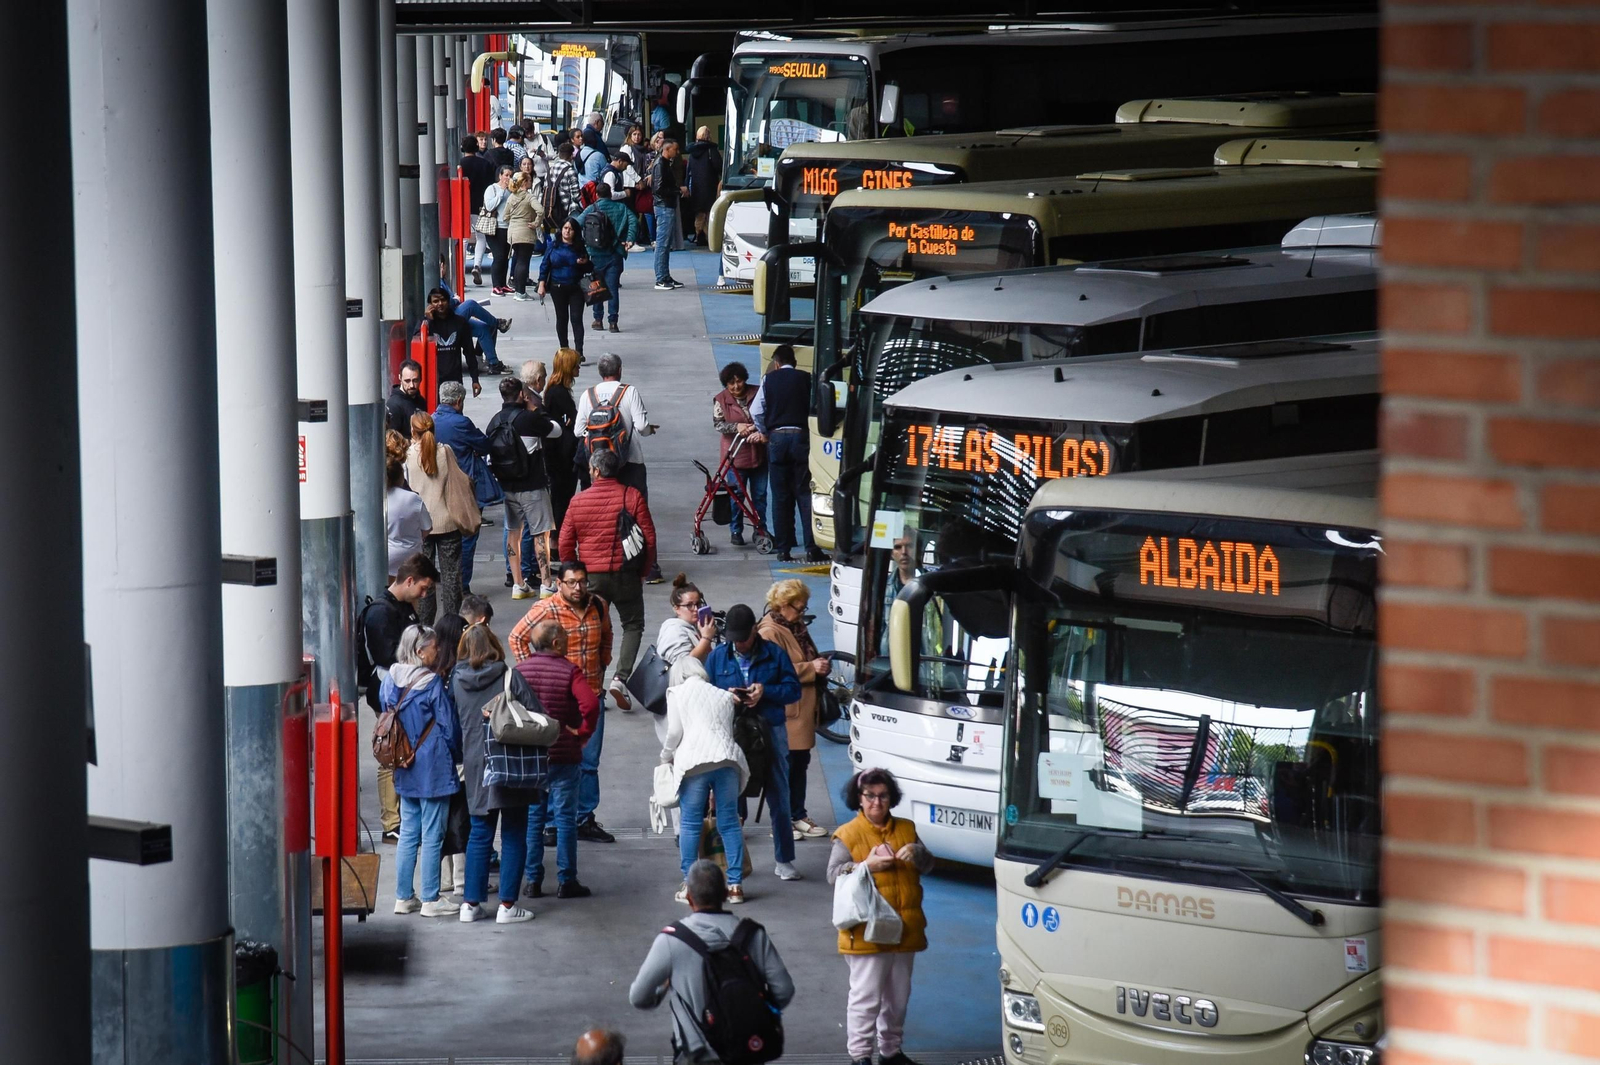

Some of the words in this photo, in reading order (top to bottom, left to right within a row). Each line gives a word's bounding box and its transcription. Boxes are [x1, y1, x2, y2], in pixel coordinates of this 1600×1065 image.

[783, 62, 826, 78] SEVILLA
[803, 167, 838, 196] M166
[888, 222, 907, 238] Por
[910, 223, 958, 240] Castilleja
[961, 226, 974, 241] de
[907, 239, 917, 254] la
[920, 240, 956, 256] Cuesta
[1139, 535, 1280, 596] ALBAIDA
[871, 712, 898, 724] VOLVO
[937, 808, 966, 827] 2120
[968, 812, 992, 831] HMN
[1117, 886, 1216, 920] DAMAS
[1116, 985, 1219, 1028] IVECO
[1050, 1022, 1068, 1039] 369
